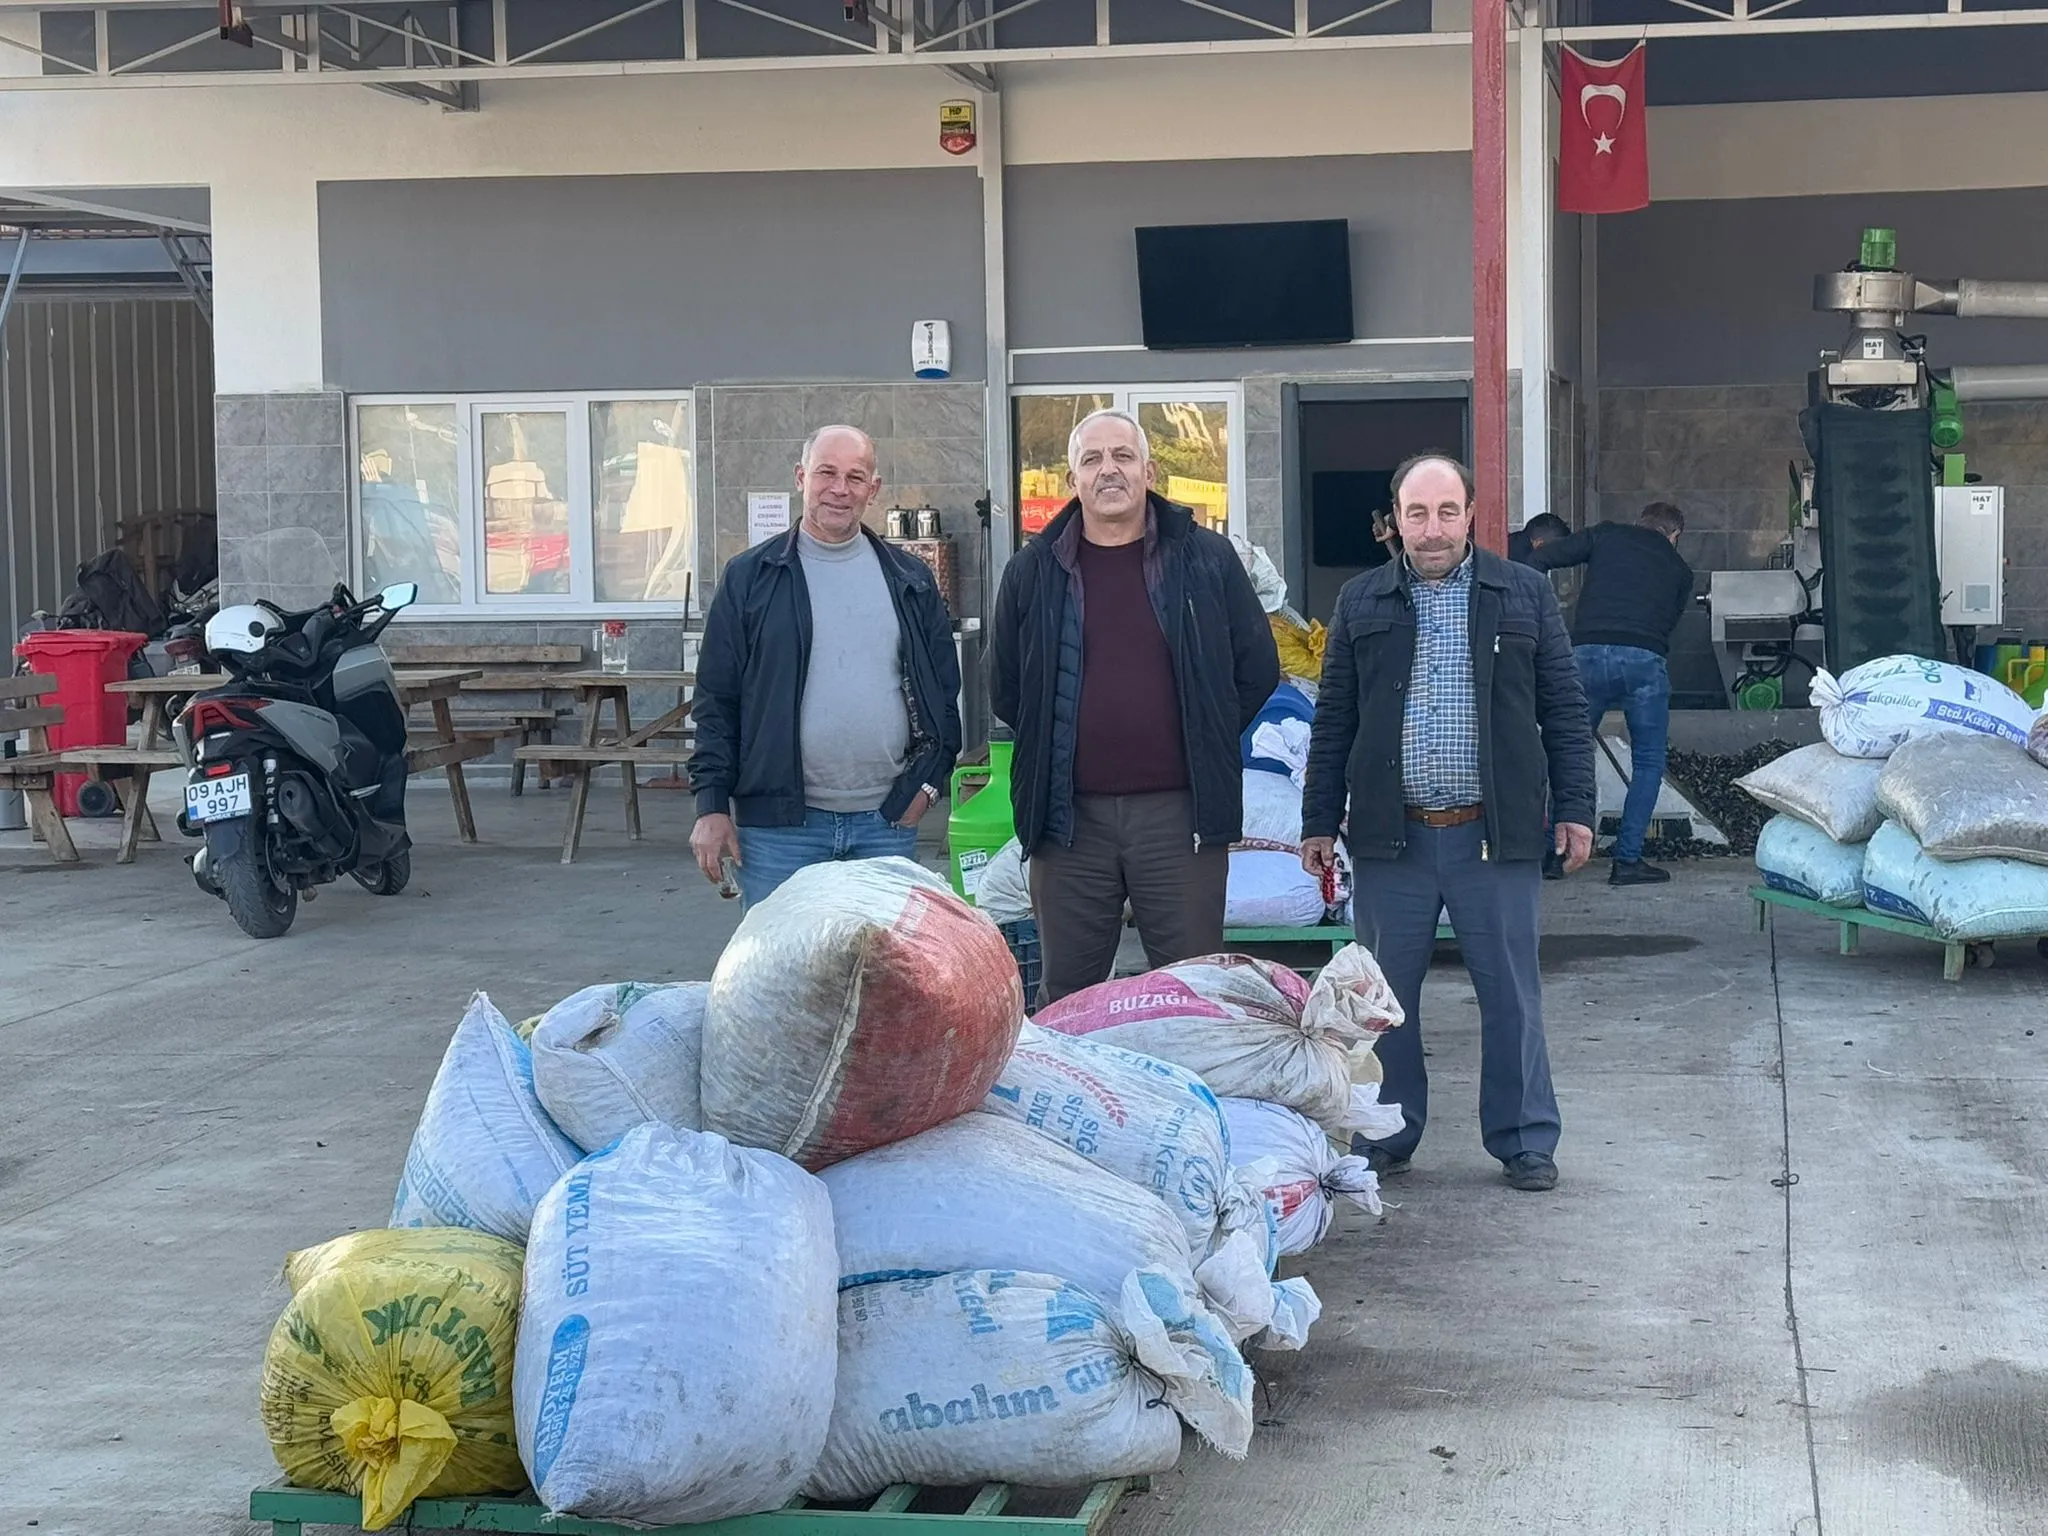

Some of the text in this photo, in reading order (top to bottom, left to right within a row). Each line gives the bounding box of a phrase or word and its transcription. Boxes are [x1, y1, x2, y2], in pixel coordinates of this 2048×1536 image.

[188, 776, 246, 801] 09 AJH
[207, 795, 238, 815] 997
[1109, 989, 1190, 1015] BUZAĞI
[561, 1169, 594, 1298] SÜT YEMİ
